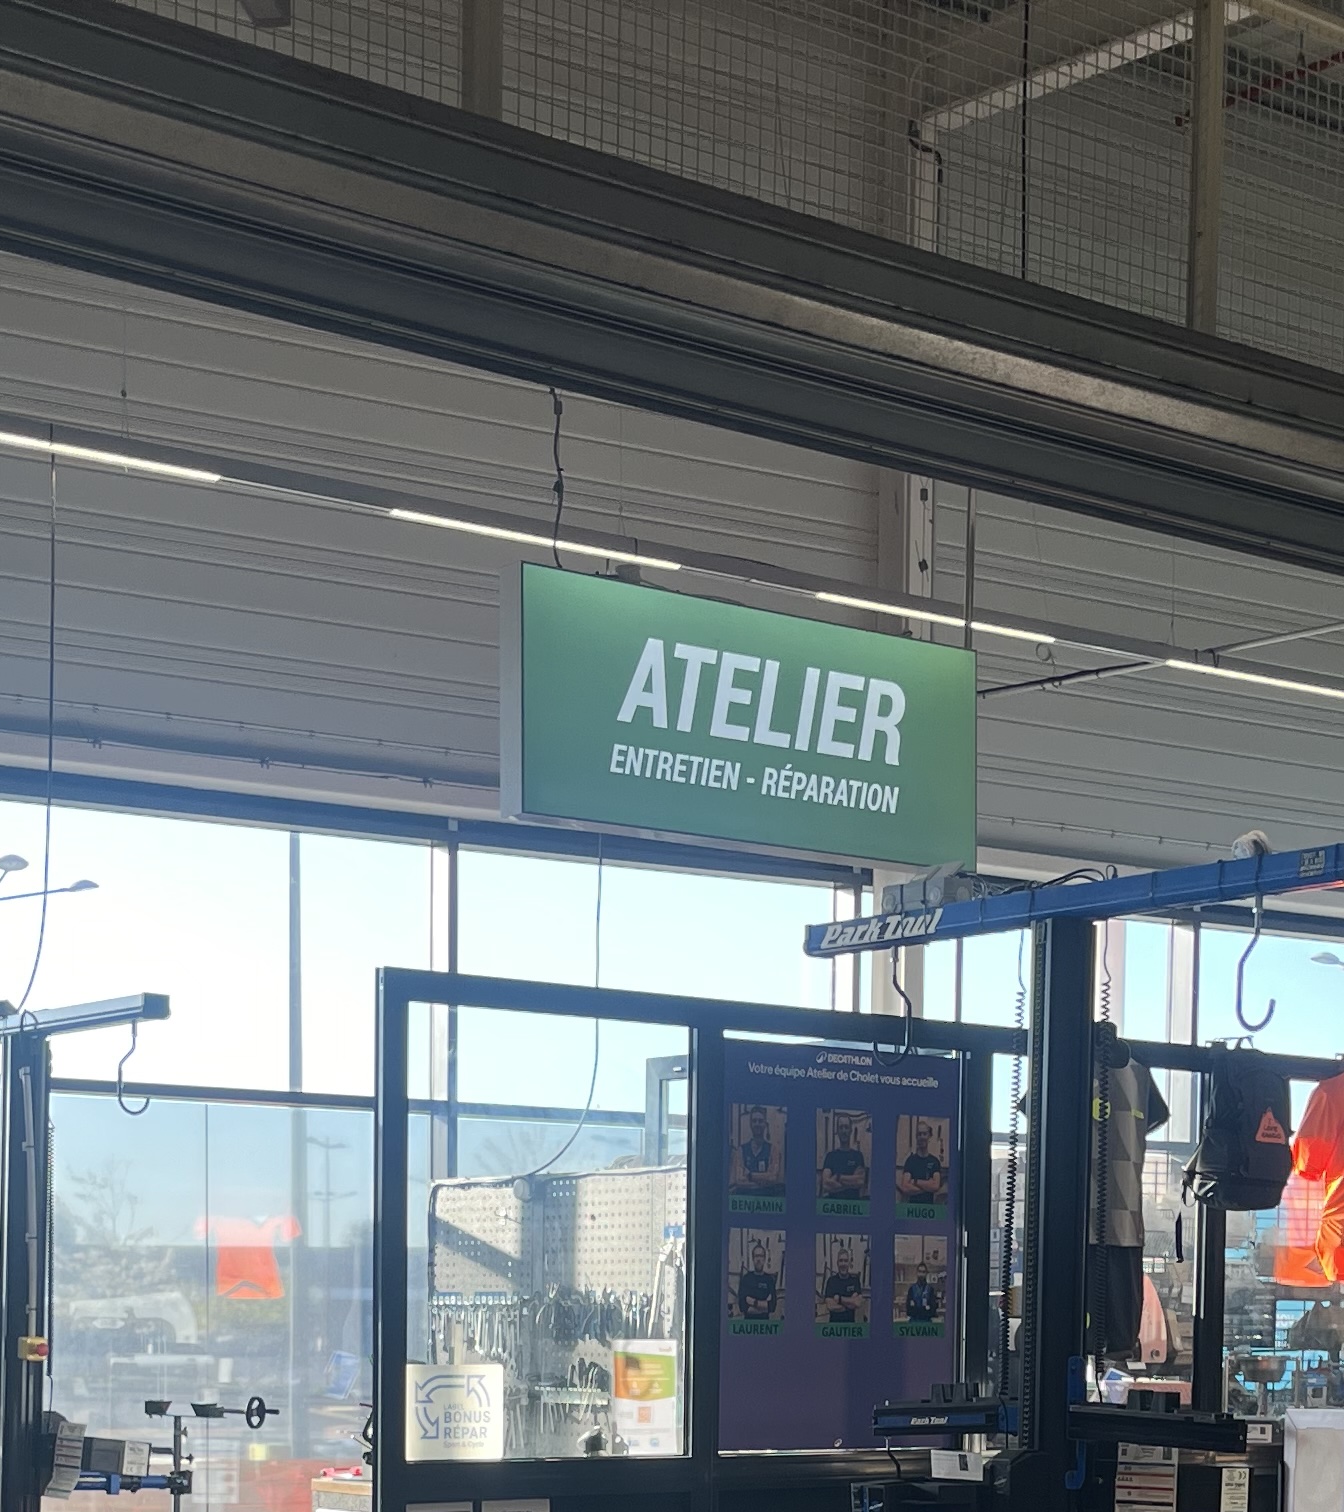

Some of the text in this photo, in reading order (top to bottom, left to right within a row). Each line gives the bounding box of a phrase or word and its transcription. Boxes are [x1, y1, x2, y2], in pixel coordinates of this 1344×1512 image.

[616, 637, 907, 766] ATELIER
[610, 743, 741, 790] ENTRETIEN
[761, 764, 899, 814] RÉPARATION
[821, 918, 883, 949] Park
[828, 1053, 872, 1066] DECATHLON
[748, 1061, 938, 1088] Votre équipe Atelier de Cholet vous accueille
[731, 1199, 783, 1213] BENJAMIN
[822, 1203, 863, 1216] GABRIEL
[907, 1208, 935, 1219] HUGO
[733, 1323, 779, 1335] LAURENT
[822, 1326, 863, 1338] GAUTIER
[898, 1326, 938, 1337] SYLVAIN
[444, 1411, 491, 1423] BONUS
[444, 1424, 487, 1439] RÉPAR
